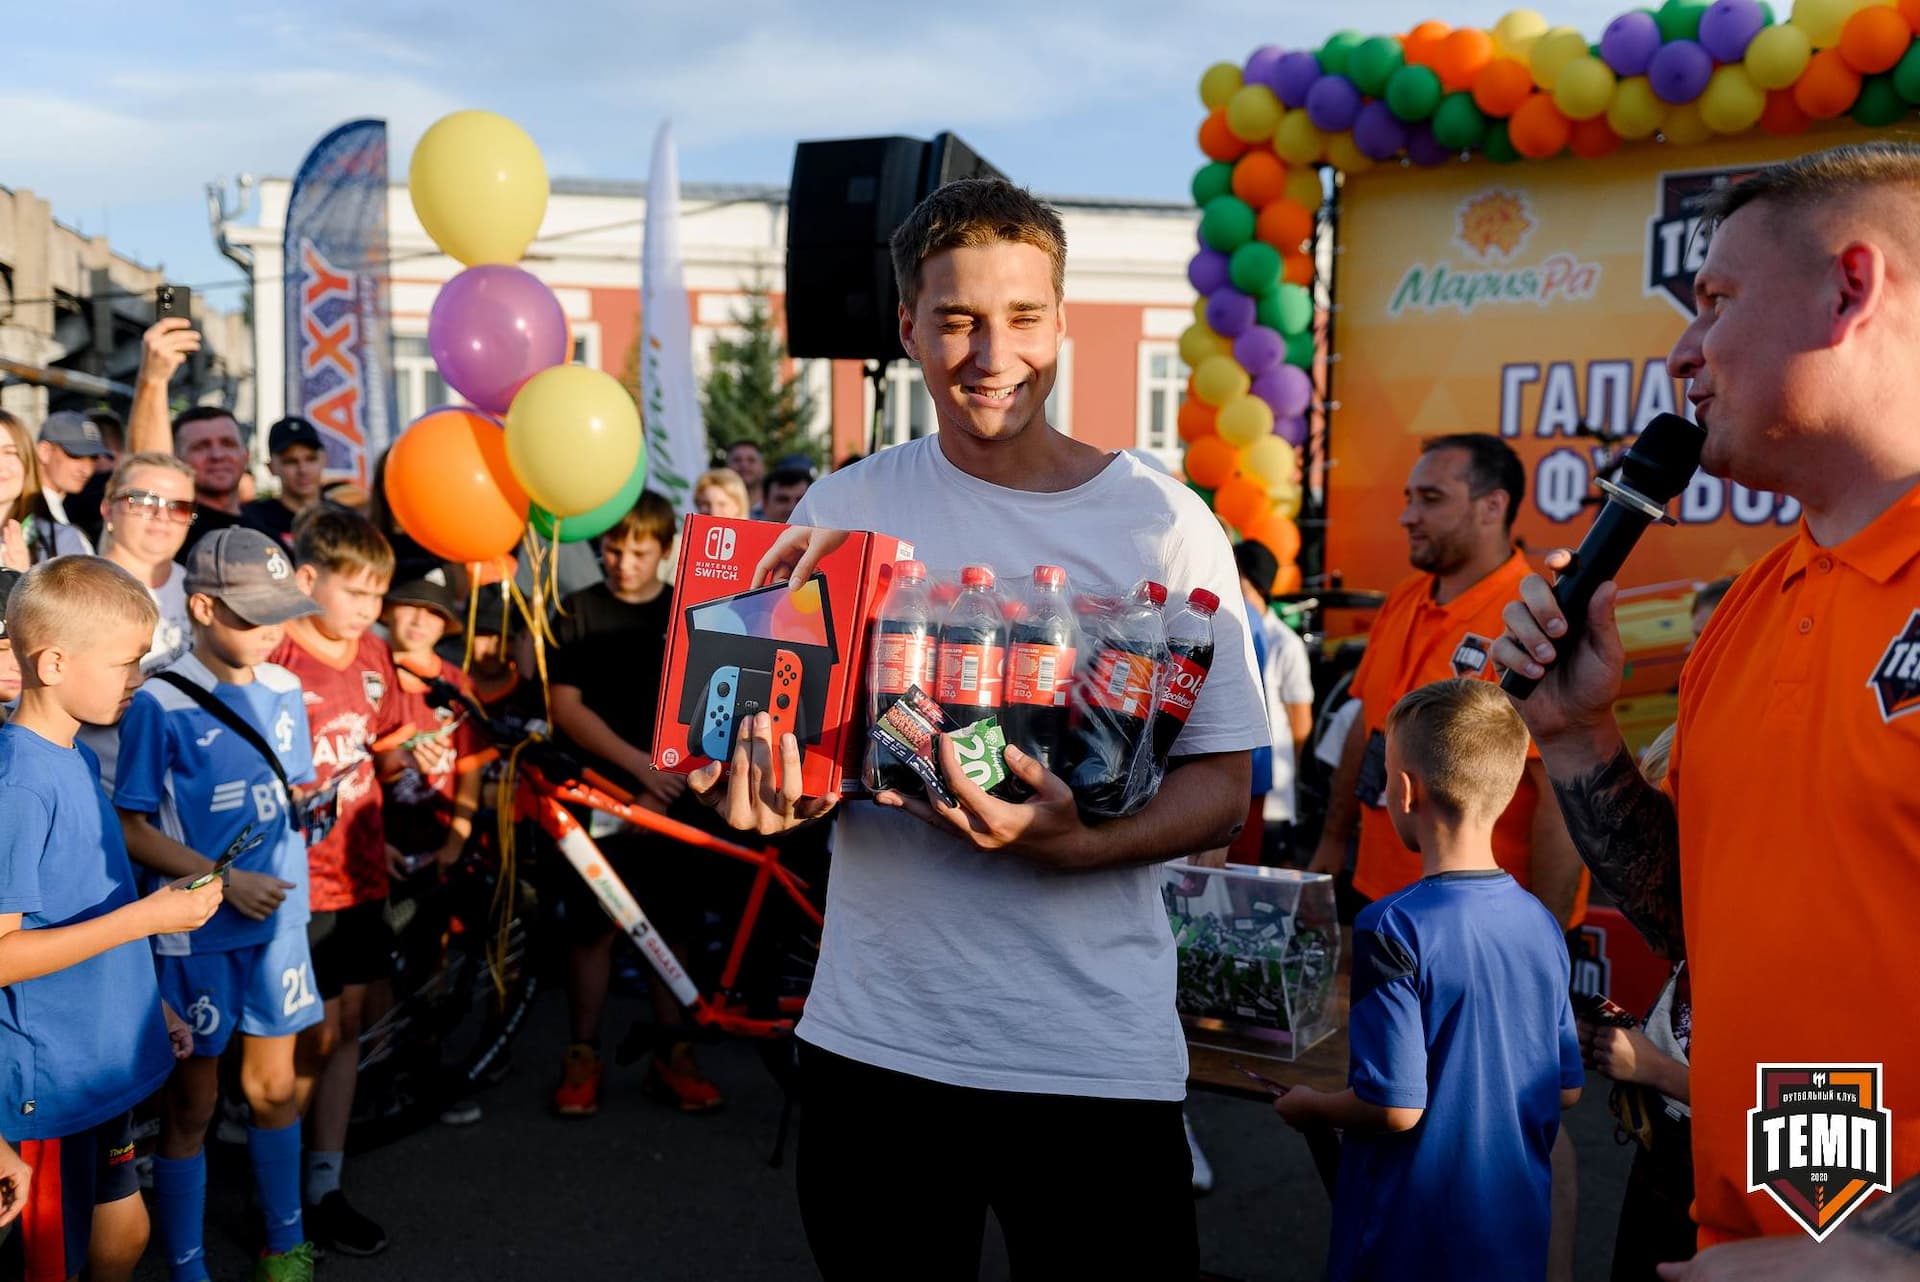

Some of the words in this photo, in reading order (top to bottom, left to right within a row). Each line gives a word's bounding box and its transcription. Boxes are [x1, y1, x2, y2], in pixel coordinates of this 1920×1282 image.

[695, 561, 738, 571] NINTENDO
[695, 567, 738, 580] SWITCH
[282, 961, 316, 1017] 21
